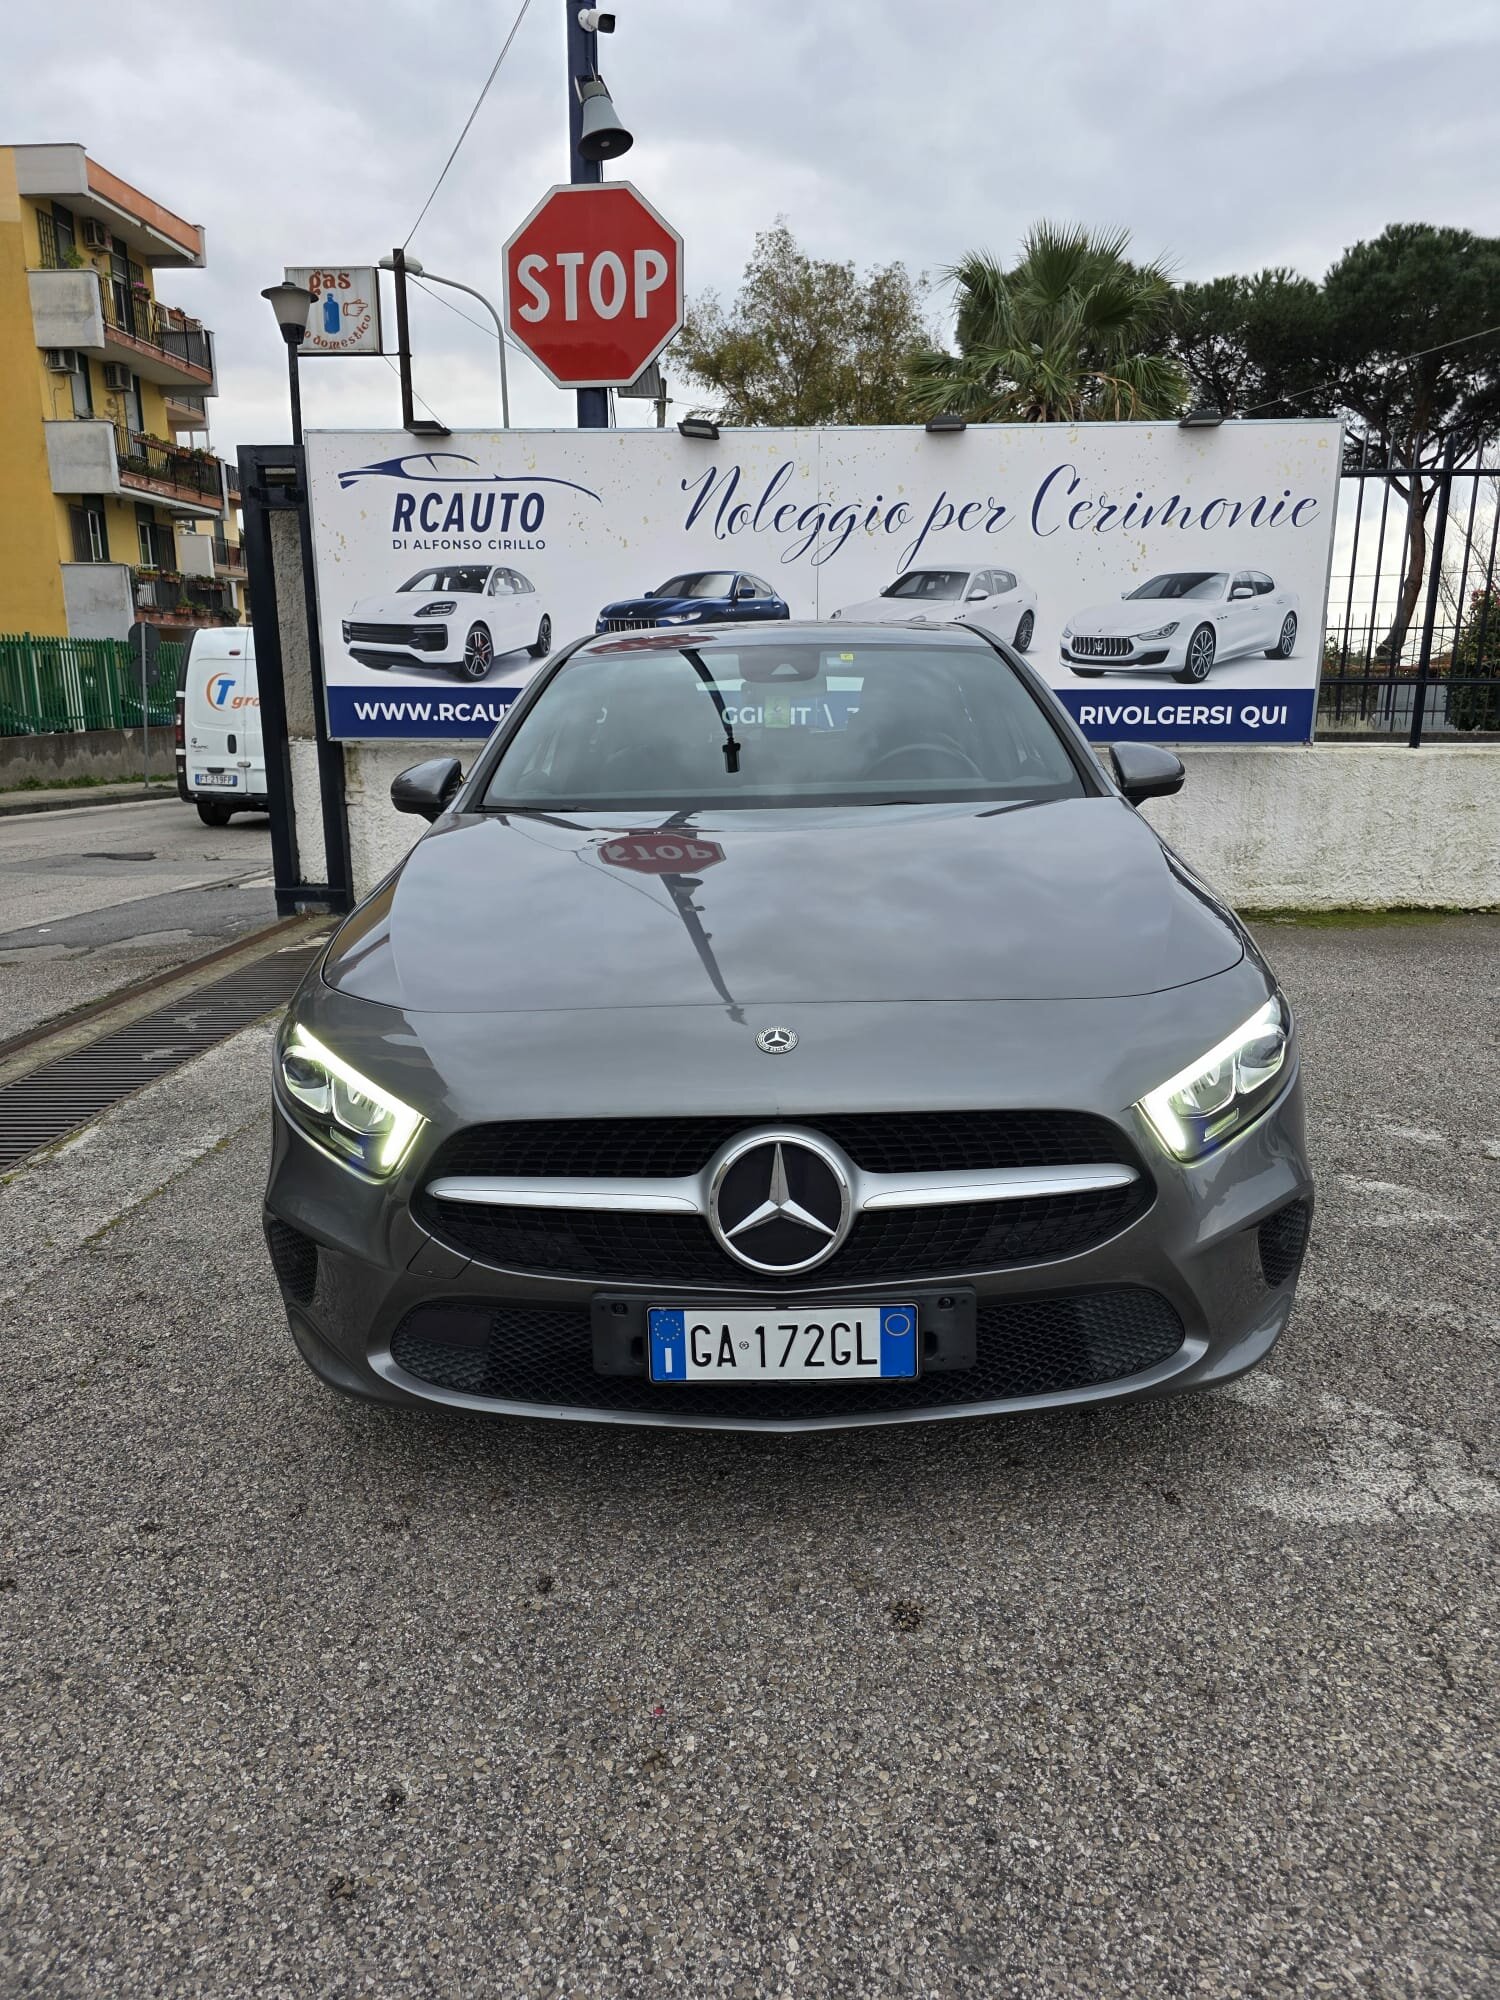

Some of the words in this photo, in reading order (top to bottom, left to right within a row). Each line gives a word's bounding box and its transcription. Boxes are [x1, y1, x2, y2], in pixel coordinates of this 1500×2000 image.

[308, 271, 351, 295] gas
[517, 249, 668, 323] STOP
[313, 314, 372, 349] domestico
[392, 492, 545, 533] RCAUTO
[681, 461, 913, 566] Noleggio
[896, 491, 1016, 575] per
[1031, 464, 1321, 537] Cerimonie
[392, 539, 407, 550] DI
[413, 539, 482, 550] ALFONSO
[488, 539, 546, 550] CIRILLO
[1079, 705, 1233, 725] RIVOLGERSI
[1240, 705, 1288, 729] QUI
